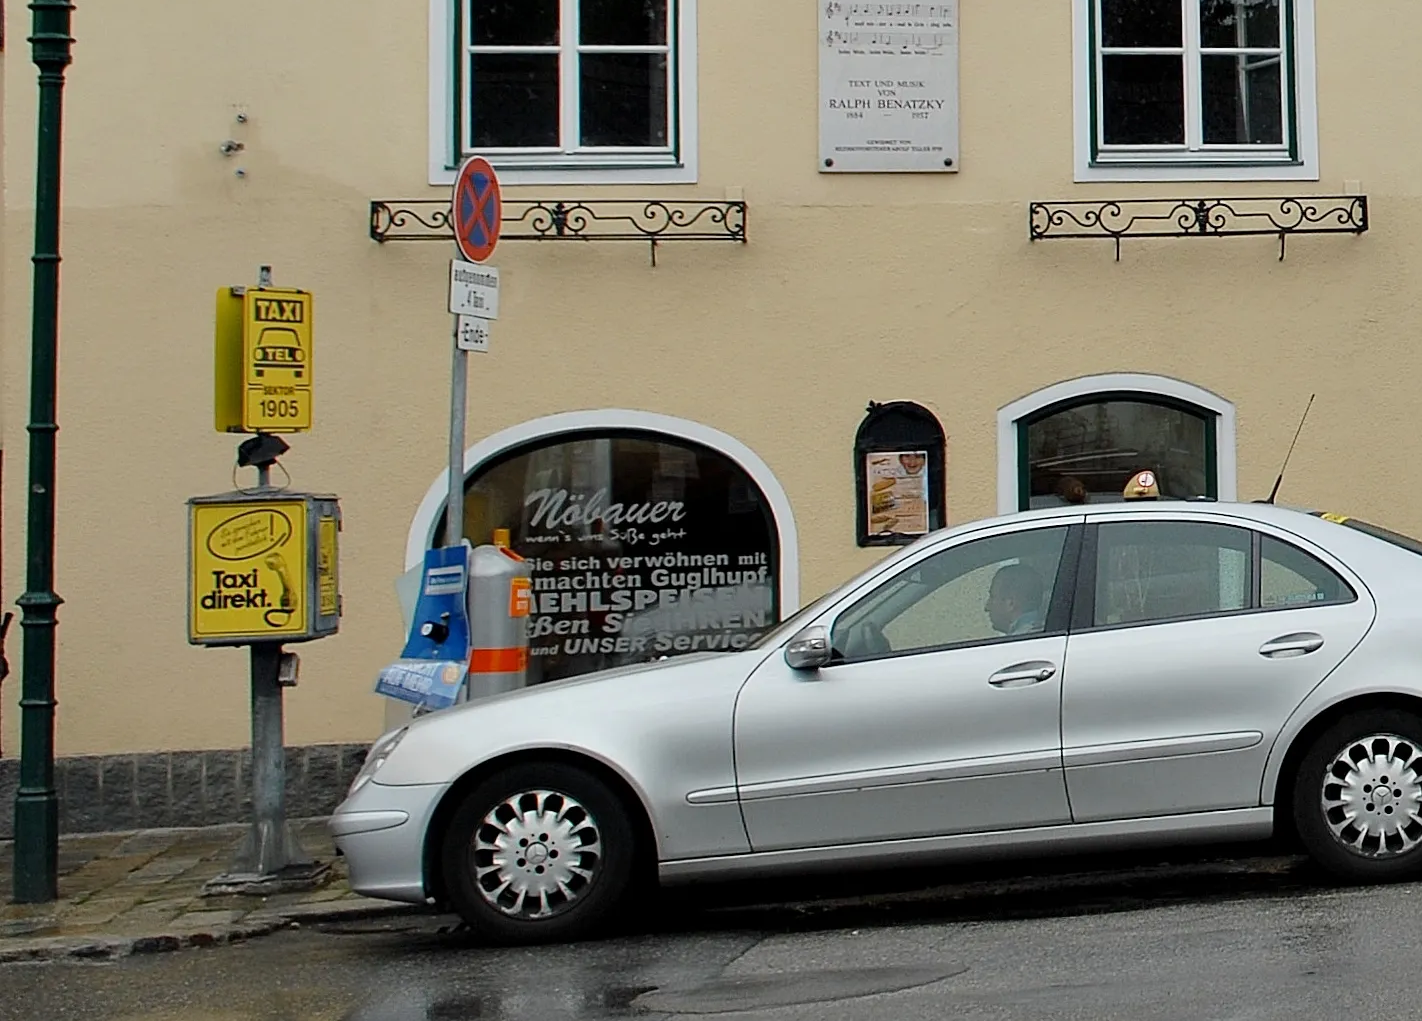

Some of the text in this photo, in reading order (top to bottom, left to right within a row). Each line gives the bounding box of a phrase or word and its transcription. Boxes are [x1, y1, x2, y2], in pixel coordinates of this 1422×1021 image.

[848, 80, 872, 88] TEXT
[874, 80, 894, 88] UND
[877, 89, 896, 97] VON
[829, 99, 945, 110] RALPH BENATZKY
[257, 300, 301, 321] TAXI
[265, 349, 293, 361] TEL
[259, 400, 299, 418] 1905
[524, 487, 687, 529] Nöbauer
[648, 528, 687, 546] geht
[525, 552, 768, 572] Sie sich verwöhnen mit
[211, 568, 258, 589] Taxi
[529, 566, 769, 591] machten Guglhupf
[201, 588, 272, 610] direkt.
[529, 585, 772, 614] EHLSPEISEN
[530, 644, 560, 657] und
[564, 637, 646, 655] UNSER
